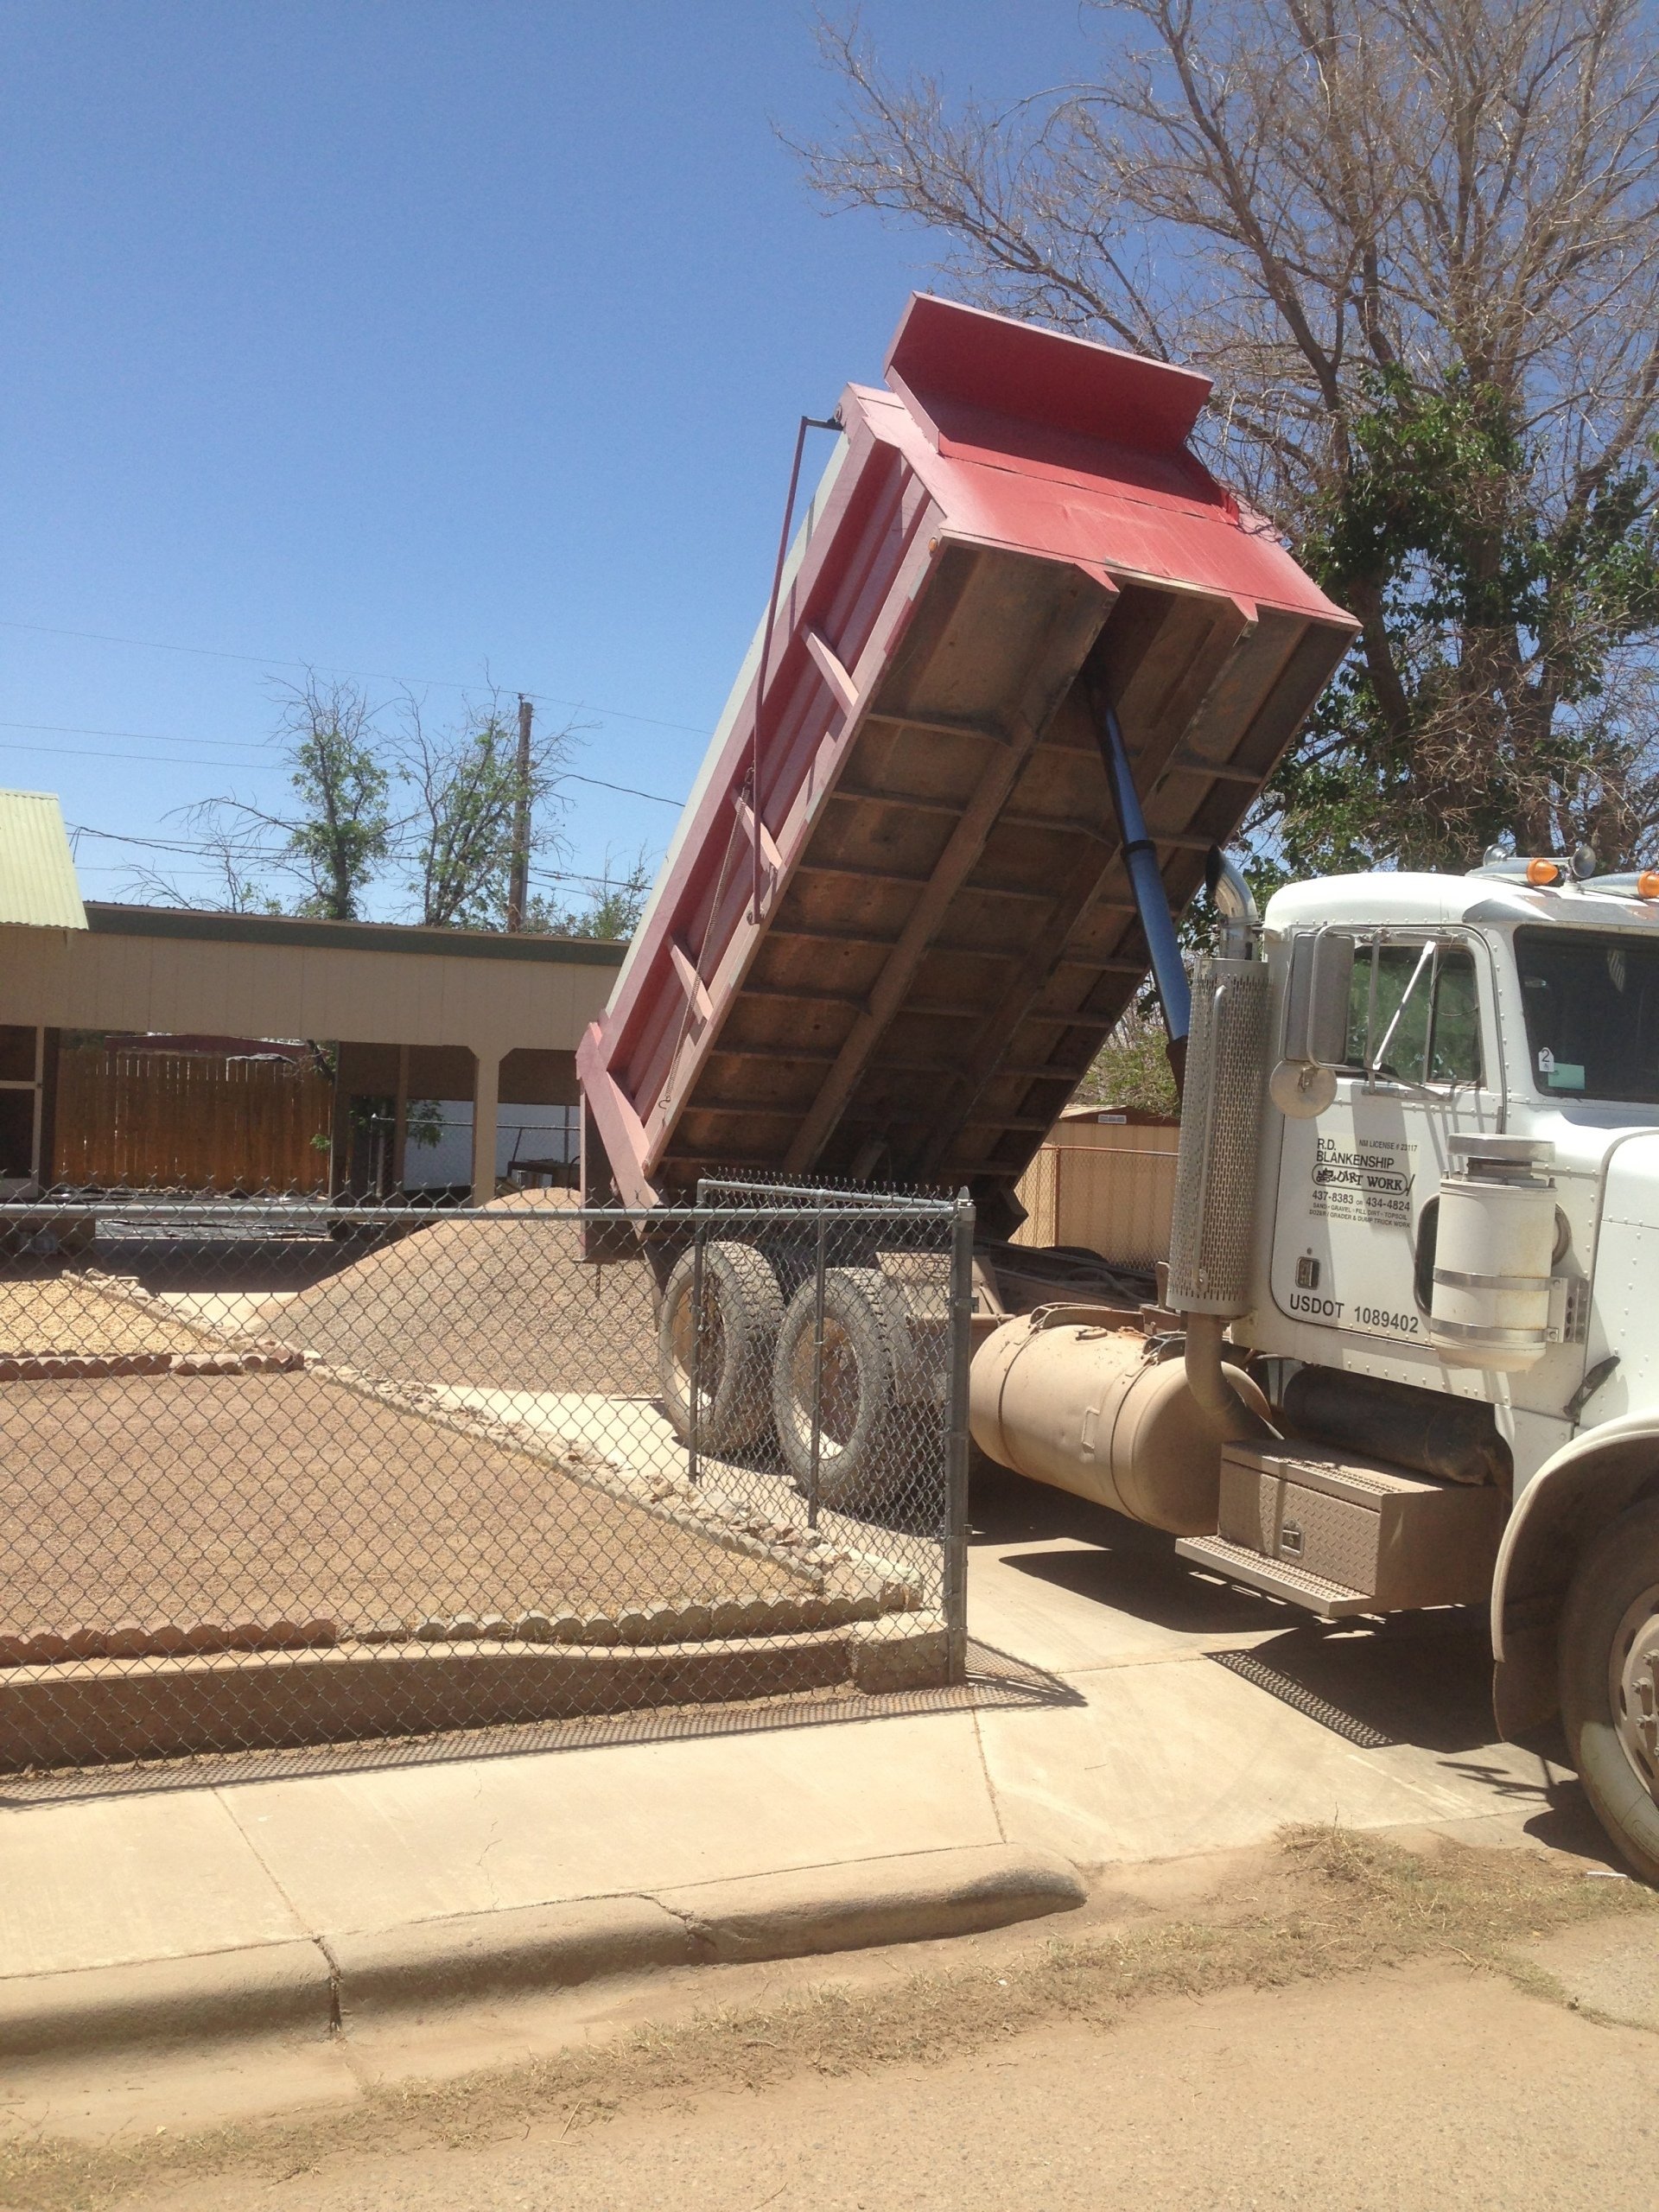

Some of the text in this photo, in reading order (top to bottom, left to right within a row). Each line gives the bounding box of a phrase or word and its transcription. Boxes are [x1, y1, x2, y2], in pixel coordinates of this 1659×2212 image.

[1541, 1049, 1549, 1062] 2
[1317, 1138, 1337, 1151] R.D.
[1370, 1141, 1395, 1150] LICENSE
[1316, 1151, 1395, 1169] BLANKENSHIP
[1337, 1171, 1402, 1191] DIRT WORK
[1313, 1190, 1353, 1205] 437-8383
[1366, 1197, 1410, 1211] 434-4824
[1290, 1294, 1419, 1333] USDOT 1089402
